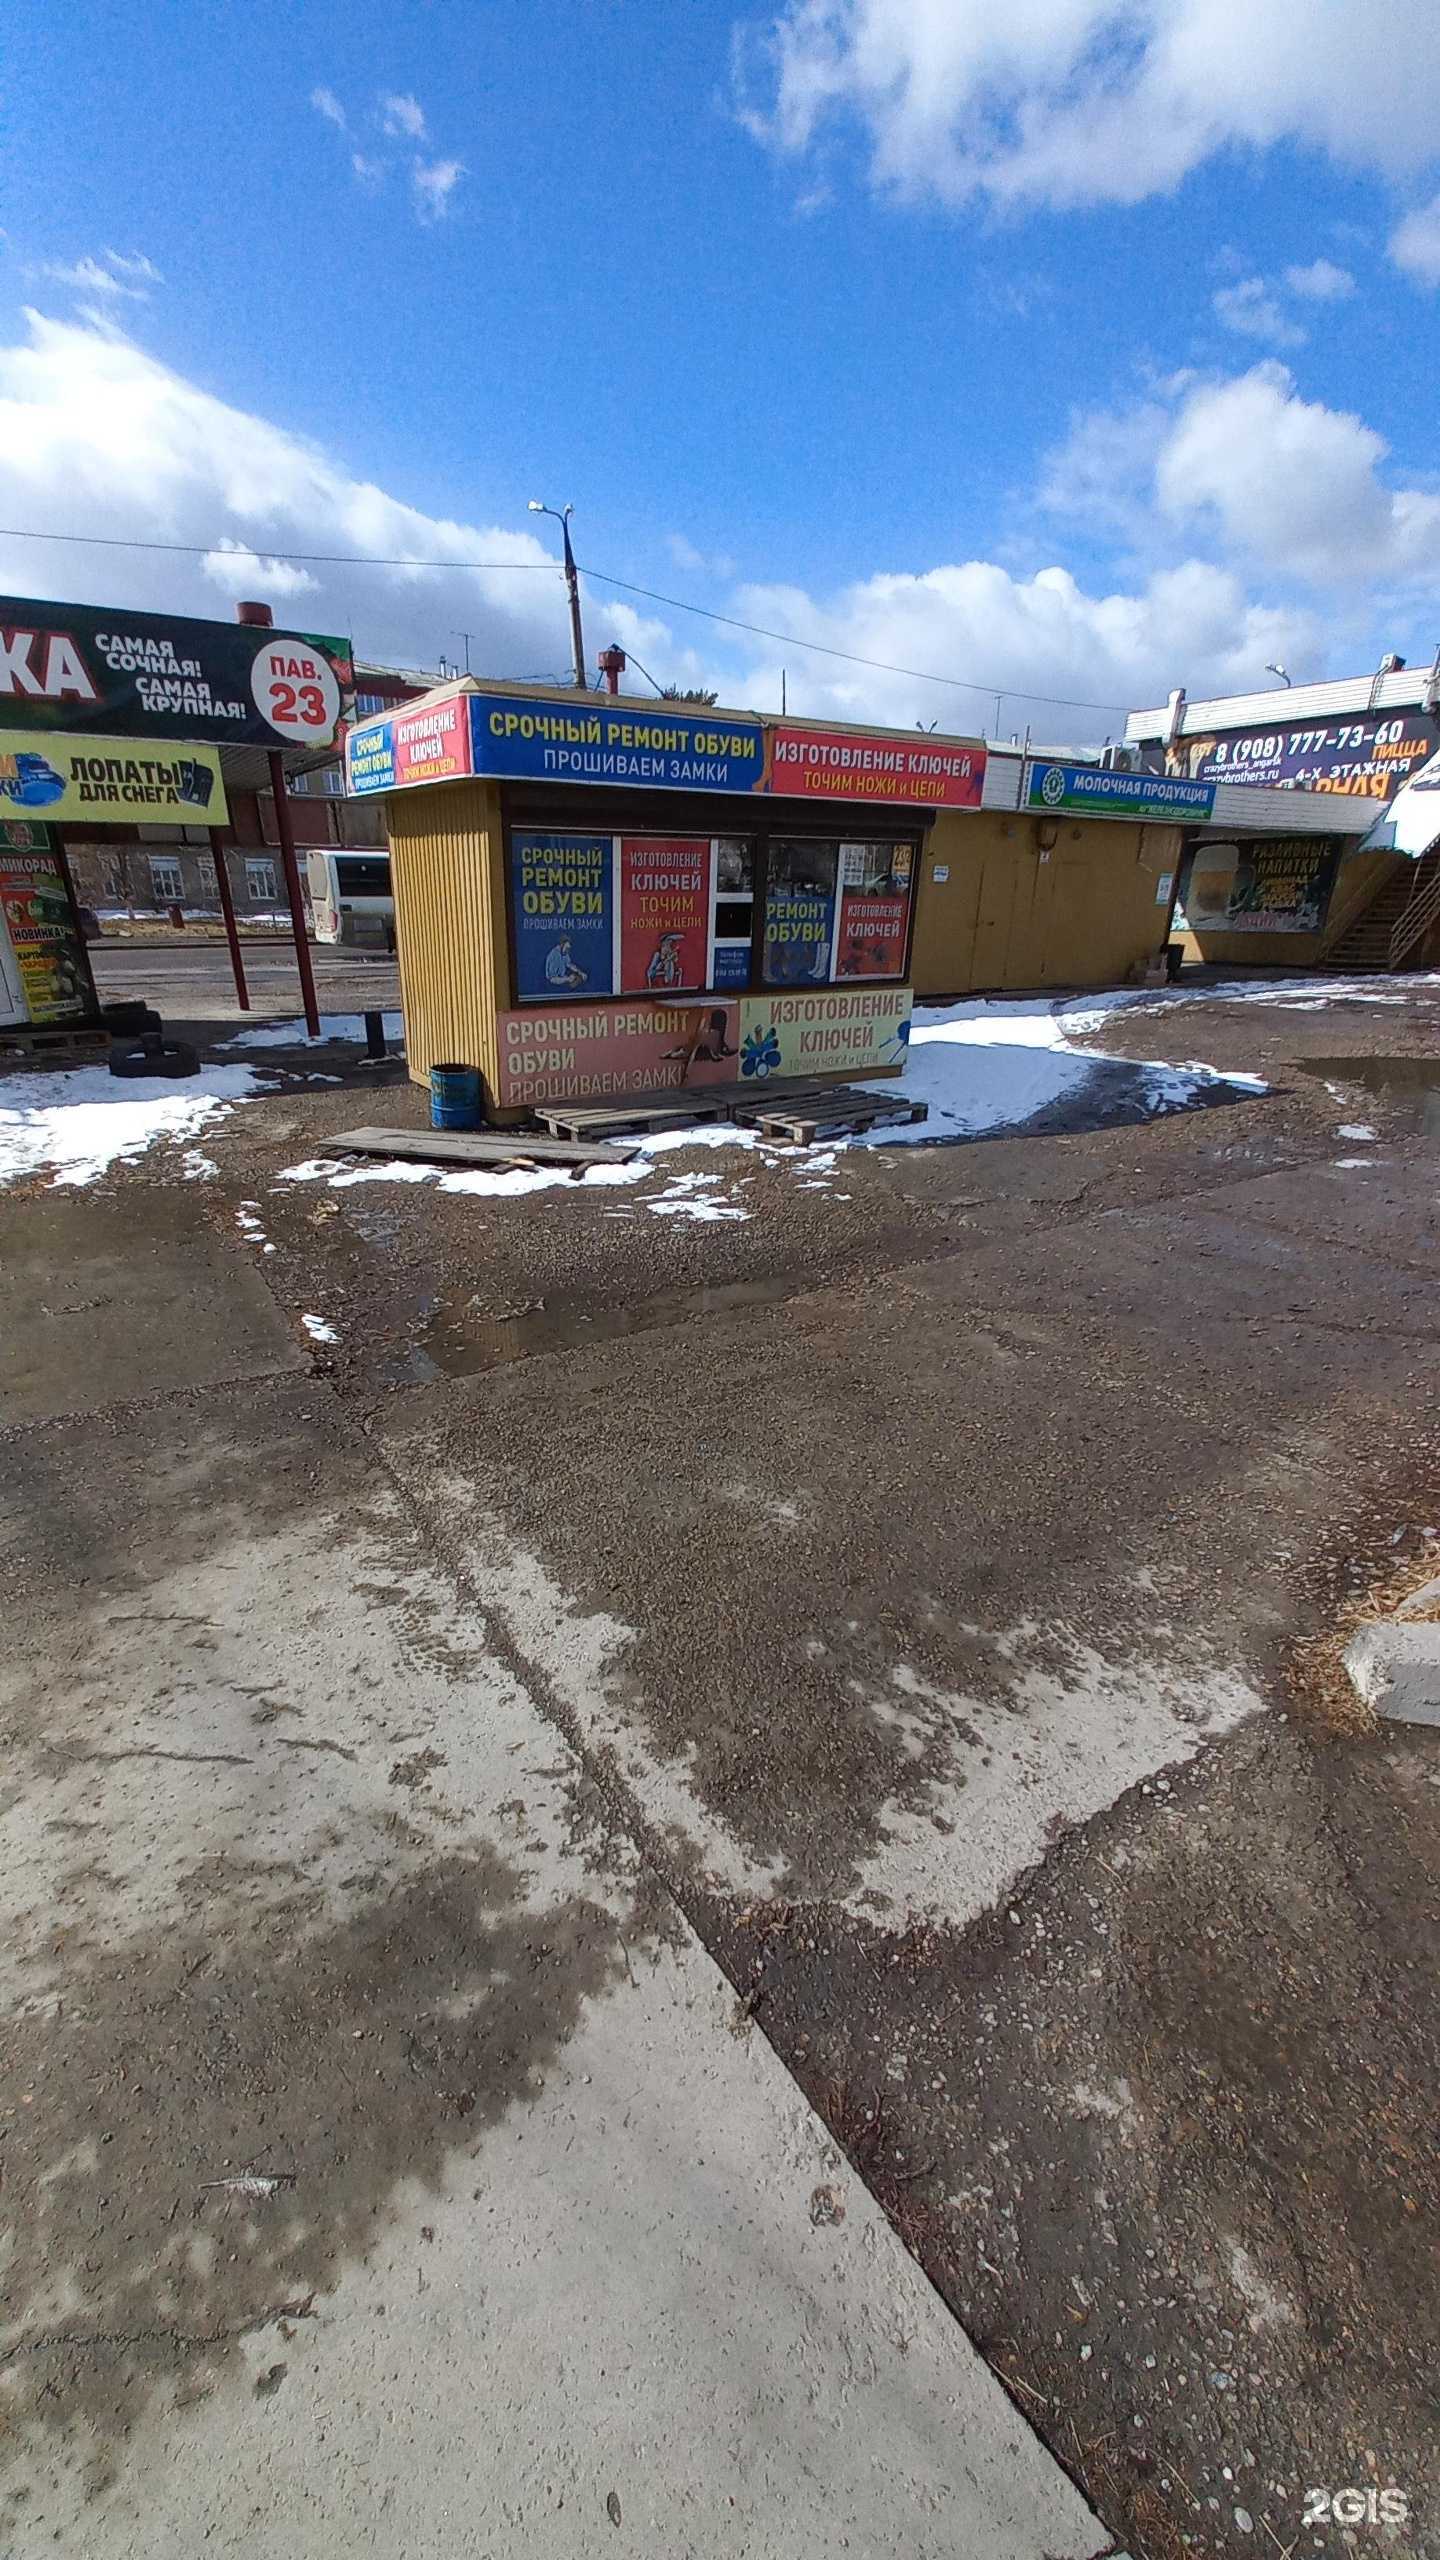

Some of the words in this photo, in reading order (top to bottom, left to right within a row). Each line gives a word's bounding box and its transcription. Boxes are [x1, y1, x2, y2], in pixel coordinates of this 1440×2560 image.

[95, 634, 174, 658] САМАЯ
[106, 652, 202, 678] СОЧНАЯ!
[269, 656, 322, 681] ПАВ.
[135, 677, 211, 700] САМАЯ
[142, 695, 247, 720] КРУПНАЯ!
[268, 682, 327, 726] 23
[397, 709, 456, 745] ИЗГОТОВЛЕНИЕ
[489, 711, 602, 745] СРОЧНЫЙ
[608, 723, 690, 753] РЕМОНТ
[694, 732, 756, 760] ОБУВИ
[410, 736, 444, 765] КЛЮЧЕЙ
[1215, 743, 1227, 764] 8
[1233, 735, 1283, 765] (908)
[1288, 720, 1404, 756] 777-73-60
[1371, 739, 1429, 762] ПИЦЦА
[70, 757, 182, 787] ЛОПАТЫ
[543, 750, 665, 778] ПРОШИВАЕМ
[670, 759, 728, 783] ЗАМКИ
[775, 741, 904, 773] ИЗГОТОВЛЕНИЕ
[908, 755, 972, 778] КЛЮЧЕЙ
[1330, 758, 1411, 780] ЭТАЖНАЯ
[79, 783, 123, 803] ДЛЯ
[124, 785, 181, 804] СНЕГА
[803, 771, 853, 791] ТОЧИМ
[856, 778, 896, 796] НОЖИ
[910, 780, 946, 800] ЦЕПИ
[1073, 775, 1141, 796] МОЛОЧНАЯ
[1142, 783, 1209, 804] ПРОДУКЦИЯ
[521, 847, 603, 866] СРОЧНЫЙ
[630, 851, 703, 869] ИЗГОТОВЛЕНИЕ
[1257, 857, 1320, 874] НАПИТКИ
[522, 867, 602, 888] РЕМОНТ
[631, 871, 701, 891] КЛЮЧЕЙ
[523, 890, 603, 915] ОБУВИ
[639, 895, 694, 913] ТОЧИМ
[766, 902, 828, 920] РЕМОНТ
[847, 904, 904, 919] ИЗГОТОВЛЕНИЕ
[523, 917, 575, 930] ПРОШИВАЕМ
[630, 917, 664, 929] НОЖИ
[672, 917, 702, 929] ЦЕПИ
[766, 922, 826, 944] ОБУВИ
[846, 921, 901, 938] КЛЮЧЕЙ
[770, 994, 905, 1025] ИЗГОТОВЛЕНИЕ
[506, 1010, 609, 1045] СРОЧНЫЙ
[614, 1011, 690, 1037] РЕМОНТ
[800, 1021, 873, 1053] КЛЮЧЕЙ
[508, 1048, 576, 1075] ОБУВИ
[508, 1071, 627, 1103] ПРОШИВАЕМ
